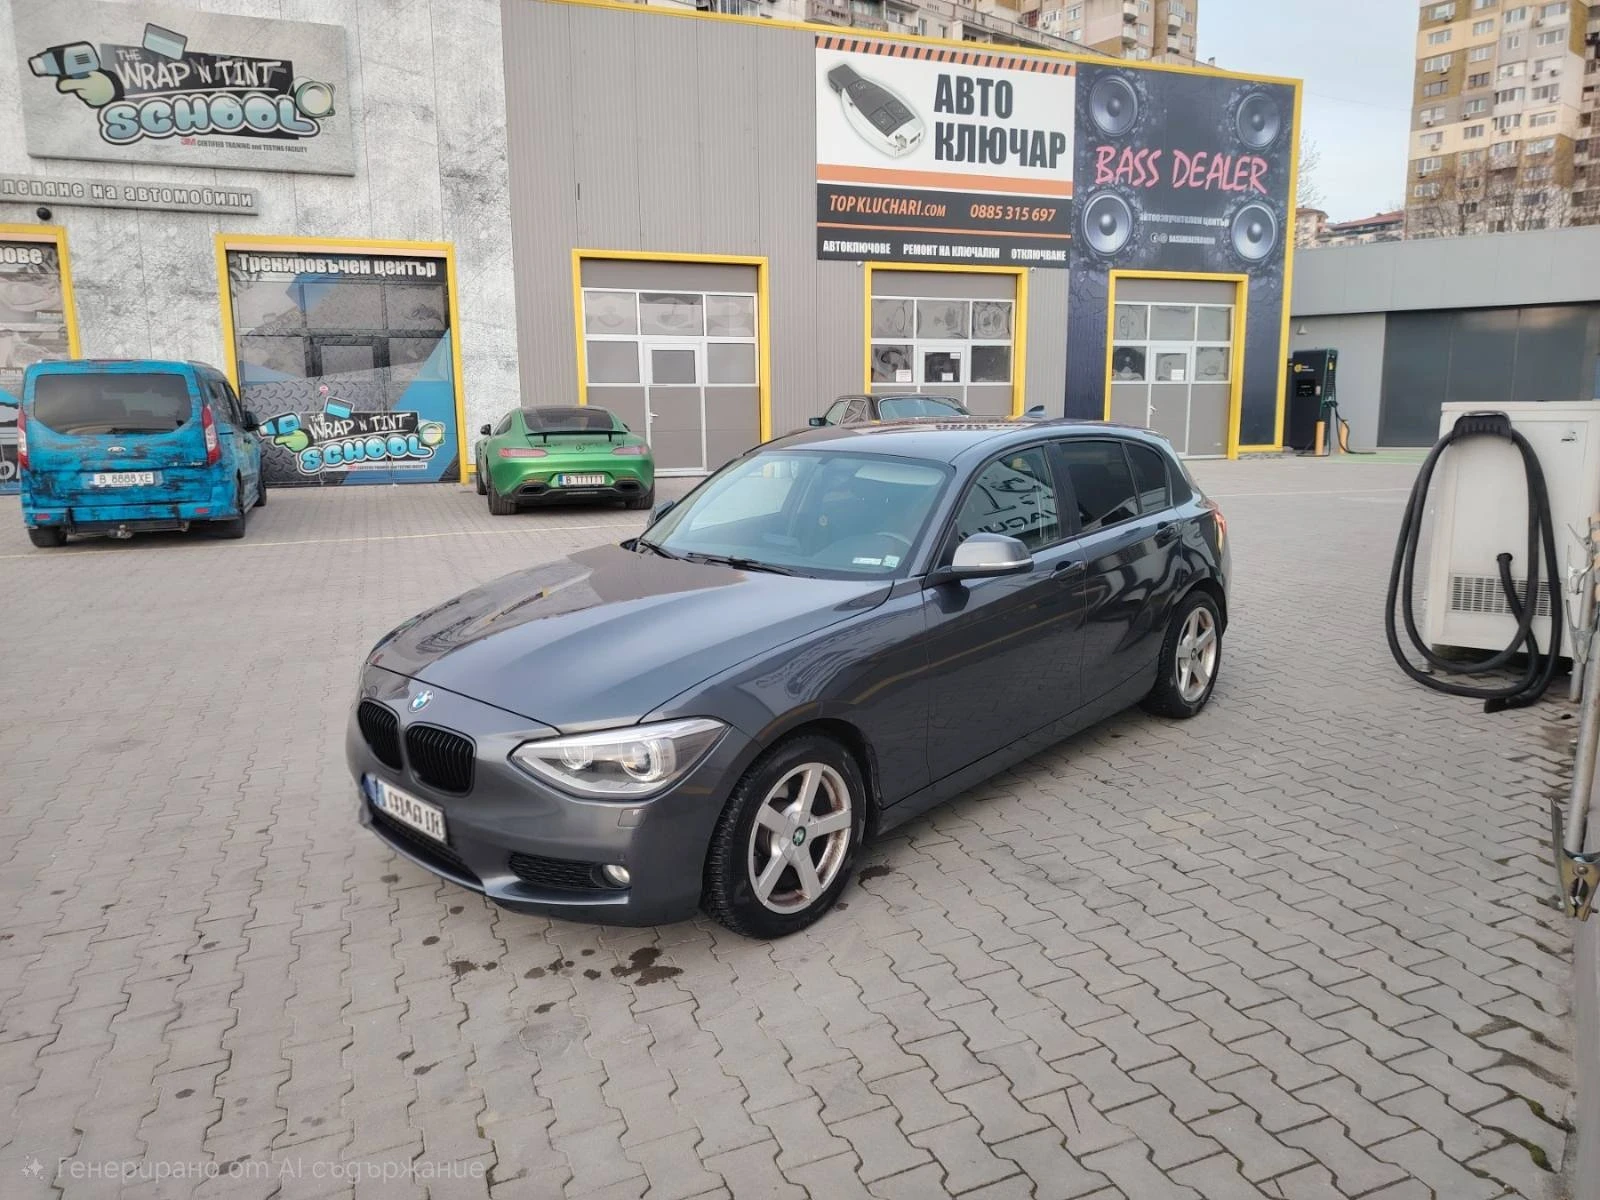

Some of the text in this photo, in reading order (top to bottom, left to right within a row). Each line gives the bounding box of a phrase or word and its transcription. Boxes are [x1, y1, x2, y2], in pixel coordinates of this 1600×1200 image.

[116, 50, 141, 61] THE
[115, 61, 191, 90] WRAP
[215, 61, 282, 87] TINT
[933, 73, 1014, 119] АВТО
[98, 92, 320, 145] SCHOOL
[934, 121, 1067, 169] КЛЮЧАР
[1095, 146, 1268, 194] BASS DEALER
[91, 183, 117, 200] на
[124, 186, 253, 207] автомобили
[969, 203, 1002, 219] 0885
[1005, 206, 1030, 221] 315
[1032, 207, 1057, 222] 697
[0, 247, 43, 264] ове
[823, 240, 1066, 261] АВТОКЛЮЧОВЕ РЕМОНТ НА КЛЮЧАЛКИ ОТКЛЮЧВАНЕ
[238, 253, 437, 278] Тренировъчен център
[308, 418, 355, 440] WRAP
[370, 413, 412, 431] TINT
[297, 434, 434, 476] SCHOOL
